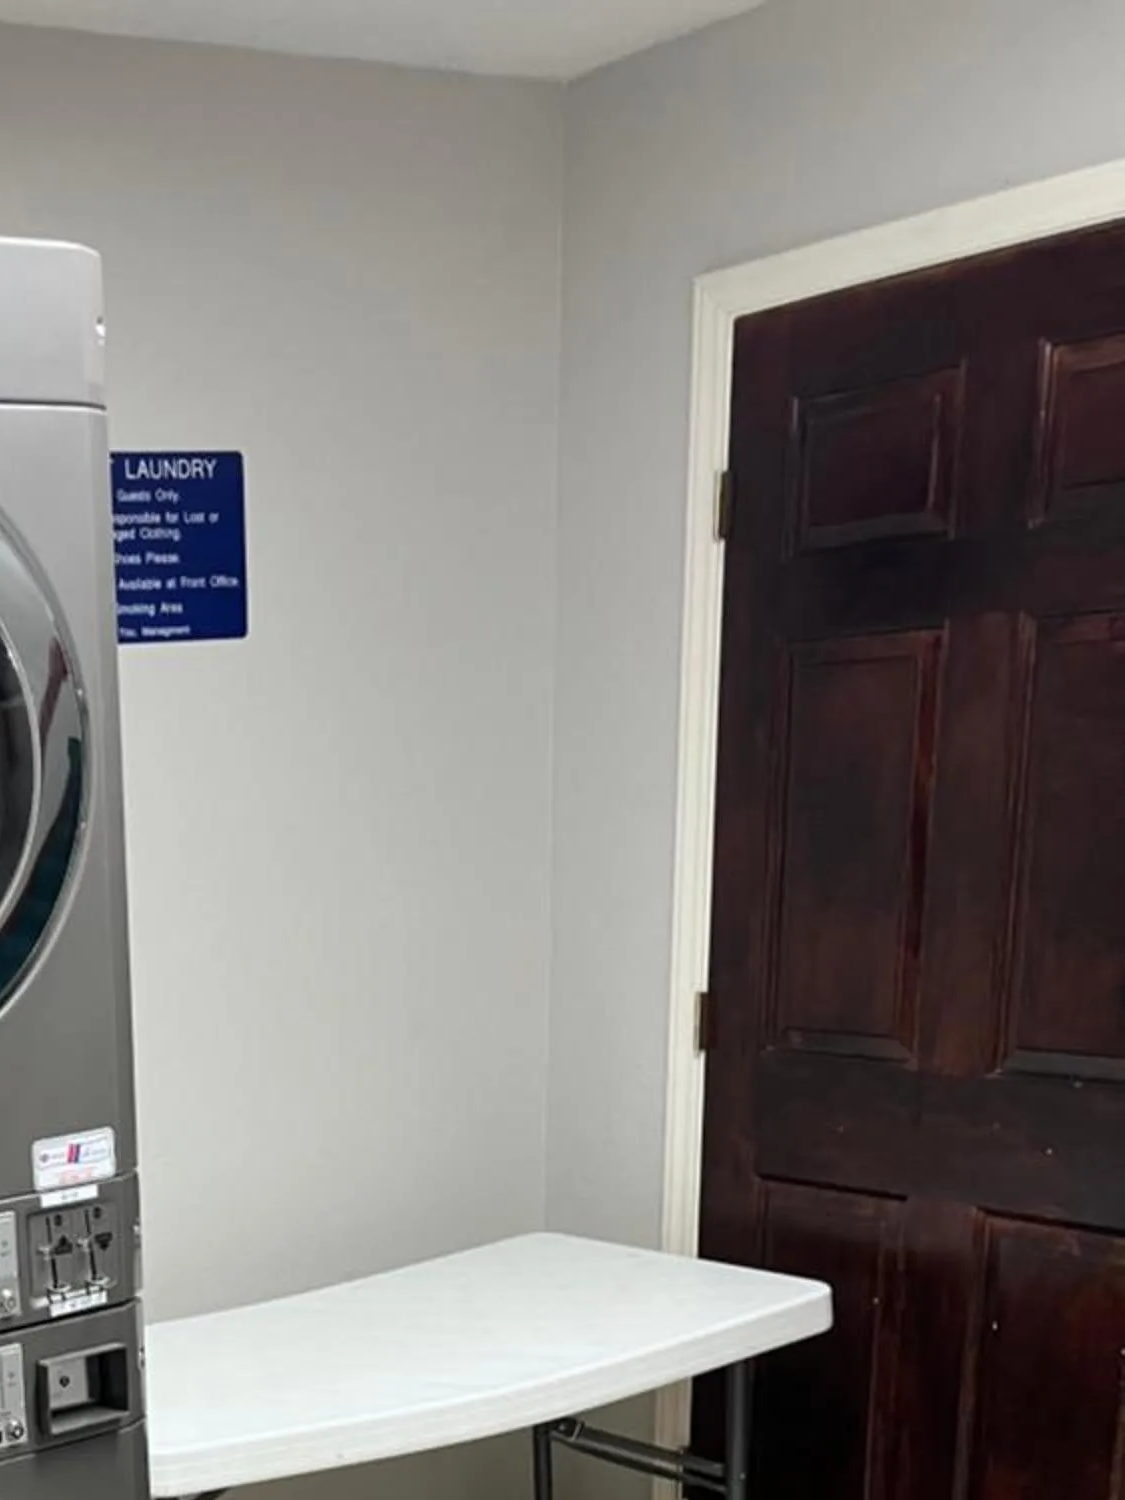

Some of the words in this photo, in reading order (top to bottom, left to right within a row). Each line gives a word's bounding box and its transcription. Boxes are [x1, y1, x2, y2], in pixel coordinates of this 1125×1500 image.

[125, 458, 217, 480] LAUNDRY
[117, 488, 151, 502] Guests
[112, 511, 161, 526] sponsible
[183, 511, 205, 524] Lost
[118, 577, 162, 590] Available
[179, 575, 206, 588] Front
[160, 601, 183, 614] Area
